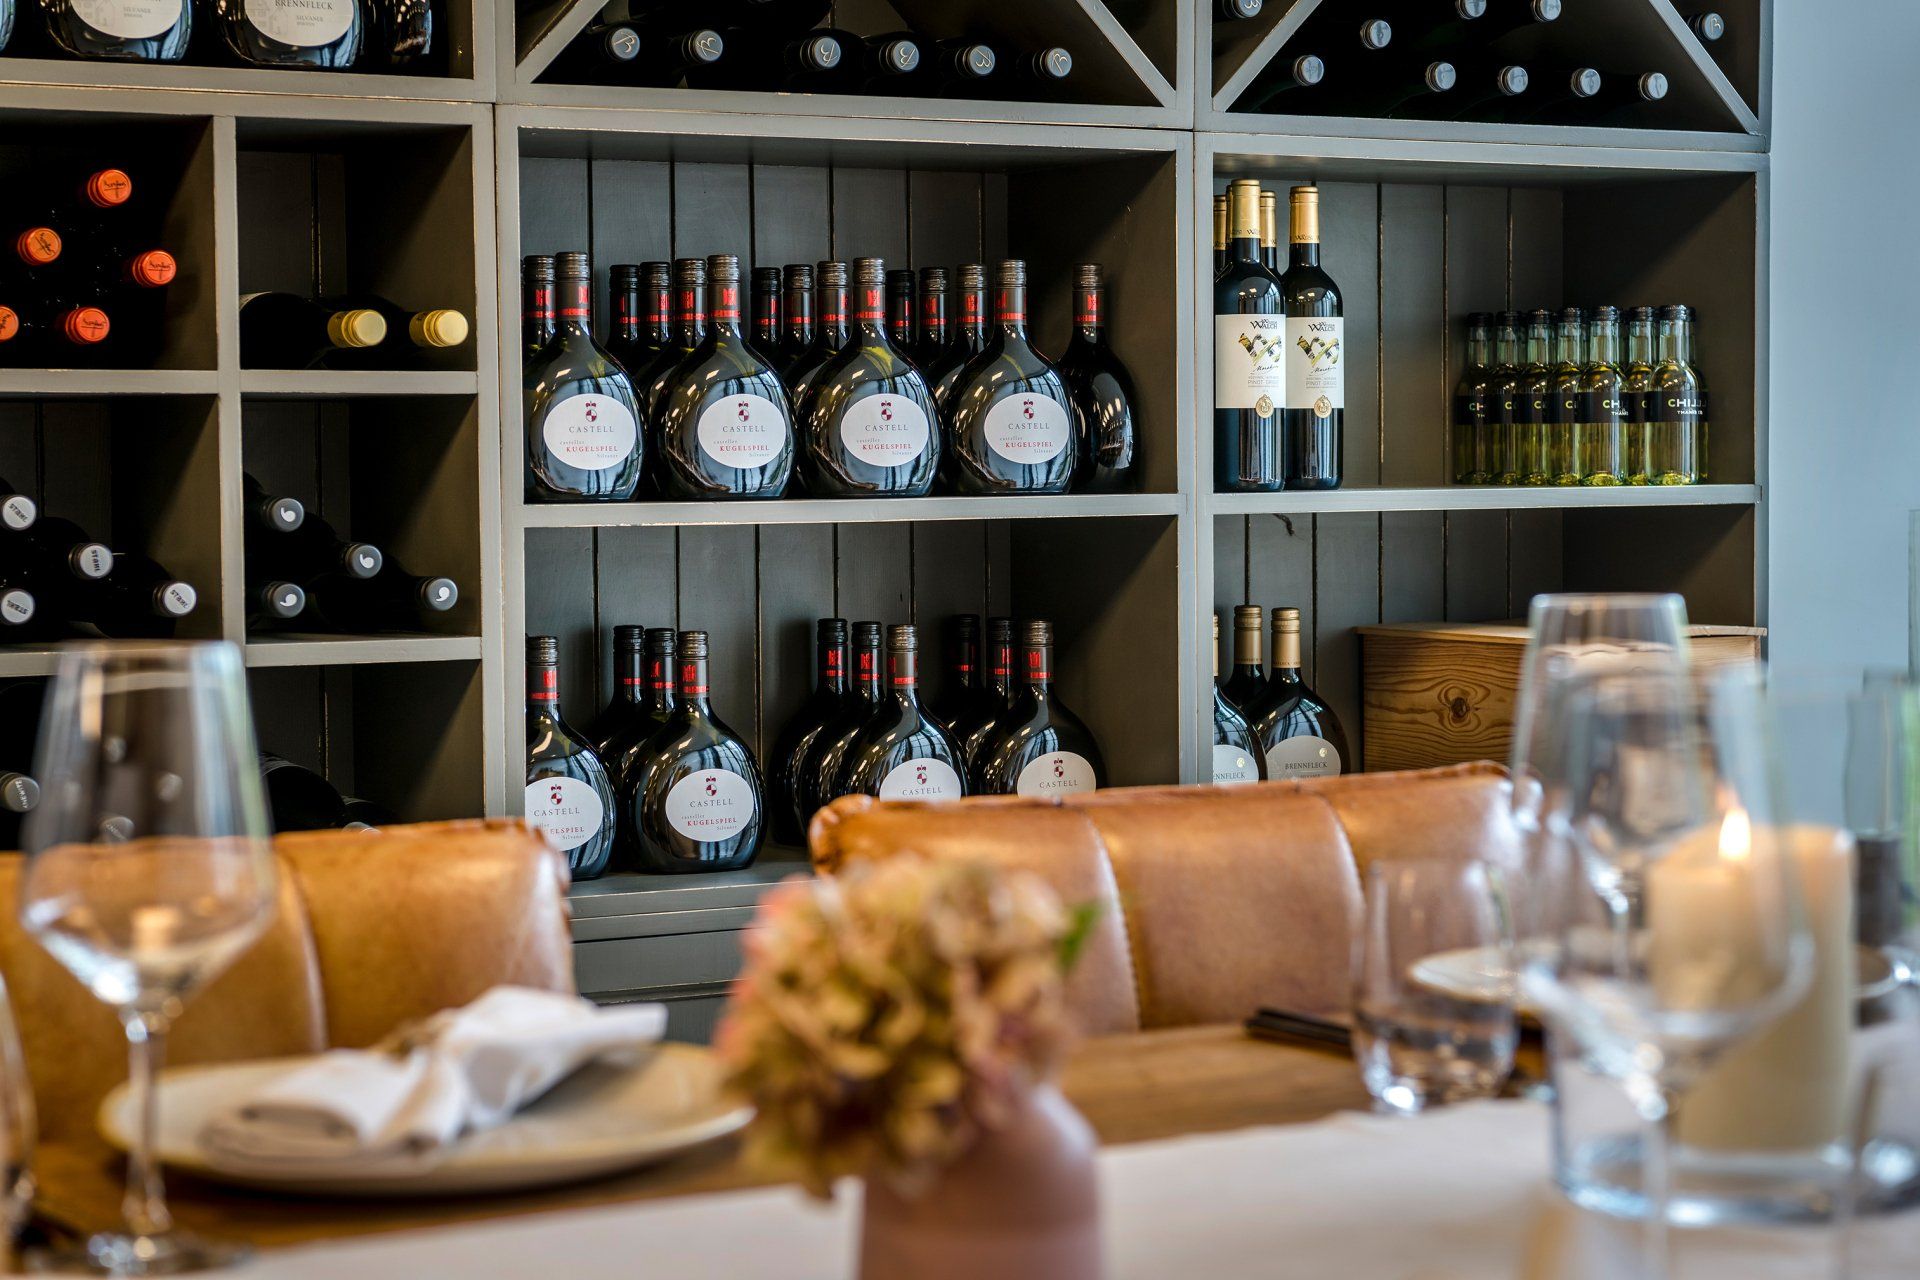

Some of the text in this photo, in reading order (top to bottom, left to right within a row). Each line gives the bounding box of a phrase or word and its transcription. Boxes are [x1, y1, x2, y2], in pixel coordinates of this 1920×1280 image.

[569, 425, 615, 433] CASTELL
[722, 425, 766, 433] CASTELL
[865, 424, 909, 432] CASTELL
[1008, 422, 1050, 430] CASTELL
[566, 445, 618, 453] KUGELSPIEL
[719, 444, 770, 452] KUGELSPIEL
[1284, 761, 1328, 770] BRENNFLECK
[1039, 779, 1079, 789] CASTELL
[902, 786, 943, 796] CASTELL
[690, 798, 734, 808] CASTELL
[533, 807, 581, 817] CASTELL
[687, 817, 737, 827] KUGELSPIEL
